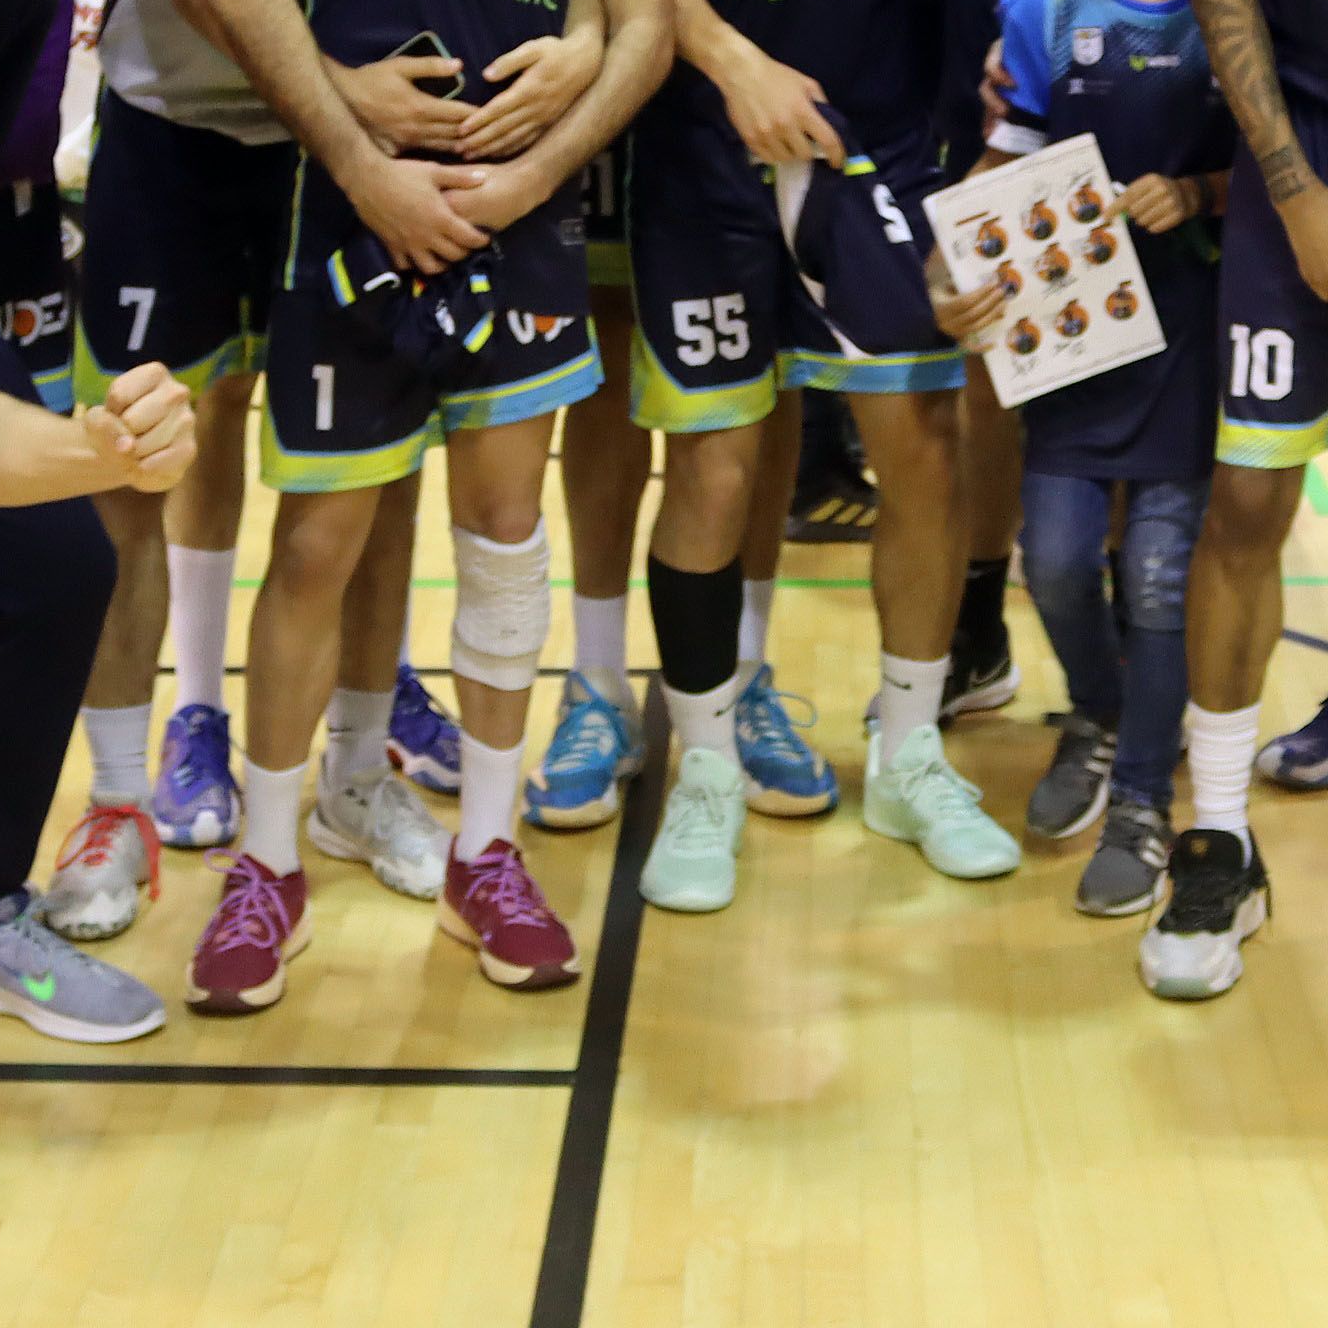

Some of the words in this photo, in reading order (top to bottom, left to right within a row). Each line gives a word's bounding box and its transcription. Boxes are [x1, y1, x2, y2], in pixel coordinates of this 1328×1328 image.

[119, 286, 157, 351] 7
[672, 293, 750, 366] 55
[312, 364, 334, 431] 1
[1229, 324, 1295, 401] 10
